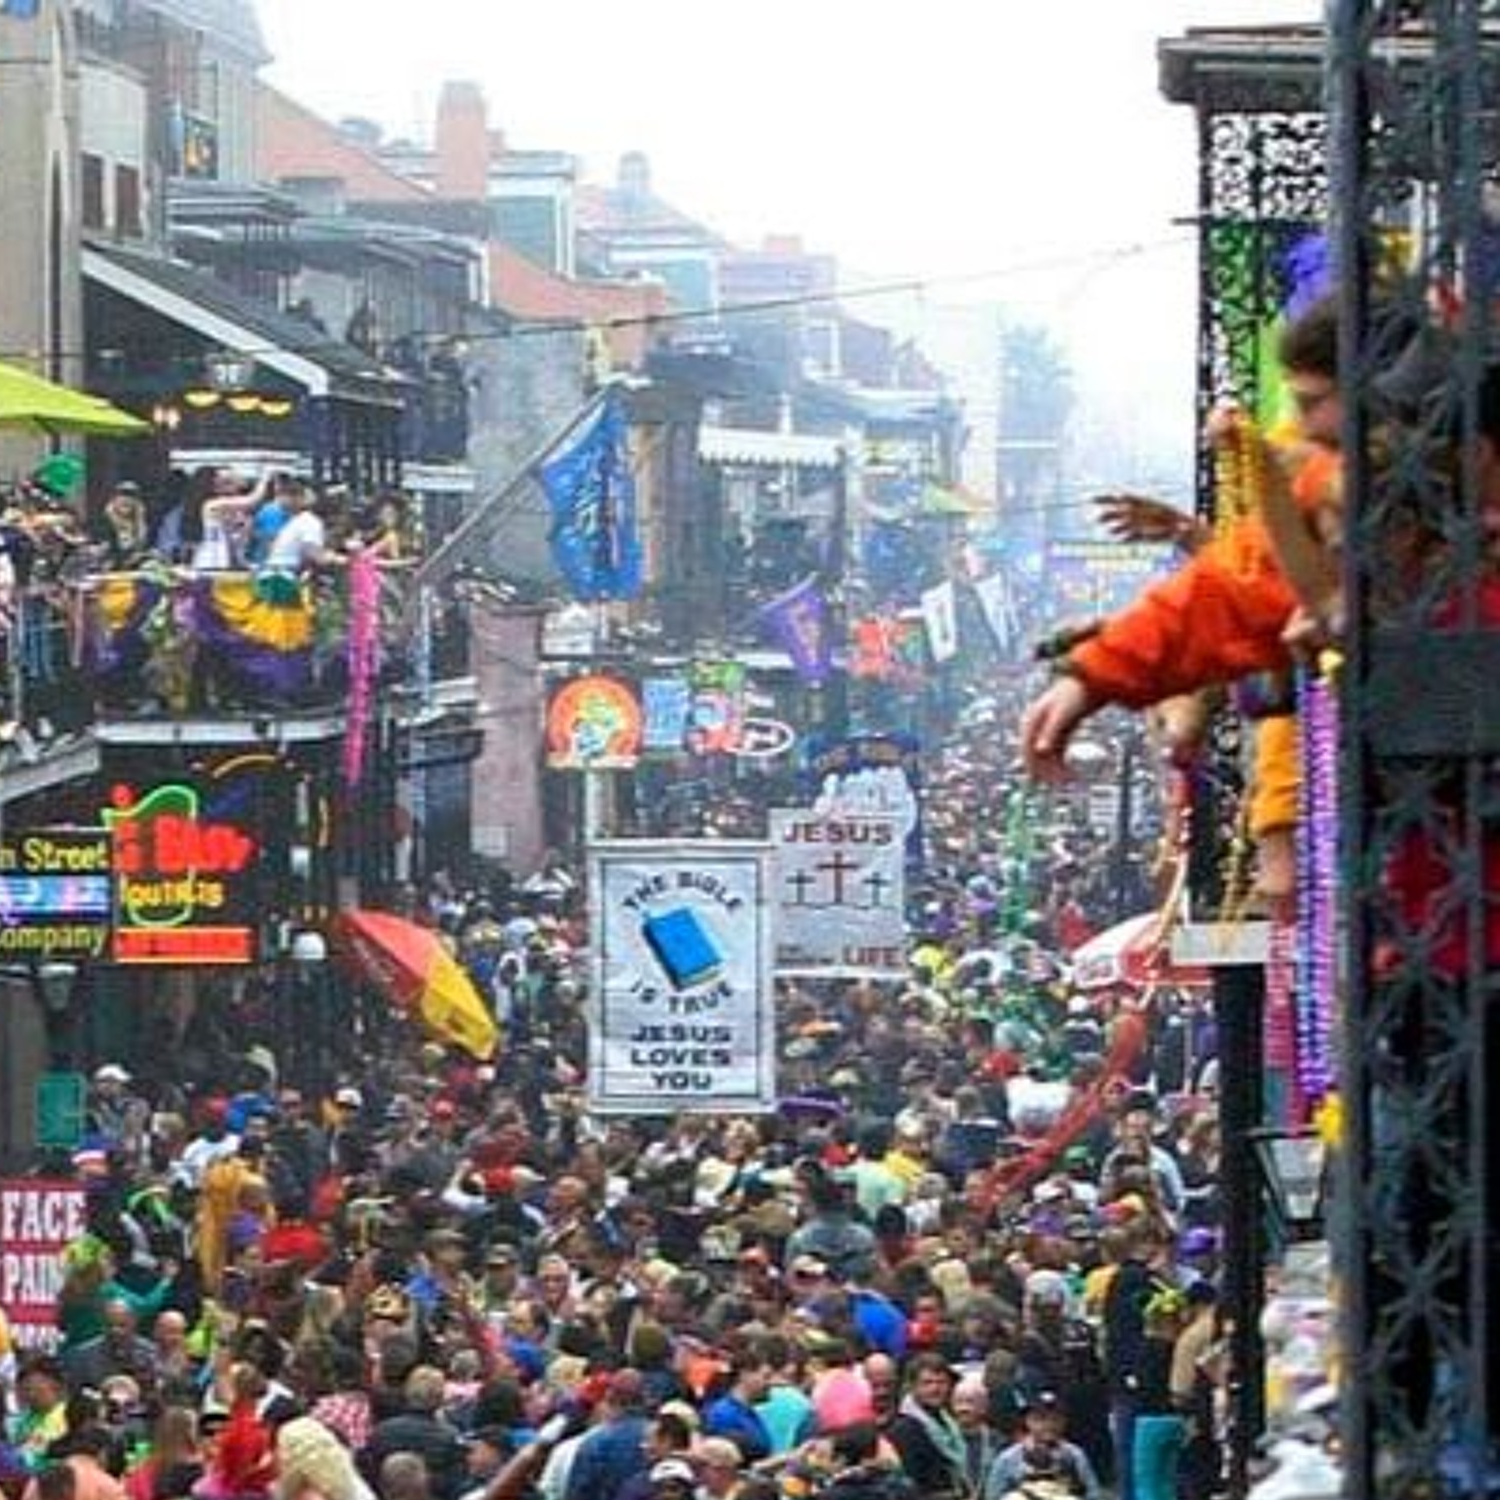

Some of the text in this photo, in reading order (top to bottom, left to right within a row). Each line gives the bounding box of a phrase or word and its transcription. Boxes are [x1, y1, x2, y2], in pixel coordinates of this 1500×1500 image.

[784, 821, 892, 845] JESUS
[23, 837, 108, 871] Street
[622, 872, 743, 916] THE BIBLE
[844, 946, 904, 967] LIFE
[668, 981, 732, 1014] TRUE
[631, 1024, 731, 1043] JESUS
[631, 1048, 731, 1066] LOVES
[652, 1071, 712, 1089] YOU
[2, 1190, 87, 1241] FACE
[2, 1254, 66, 1305] PAIN
